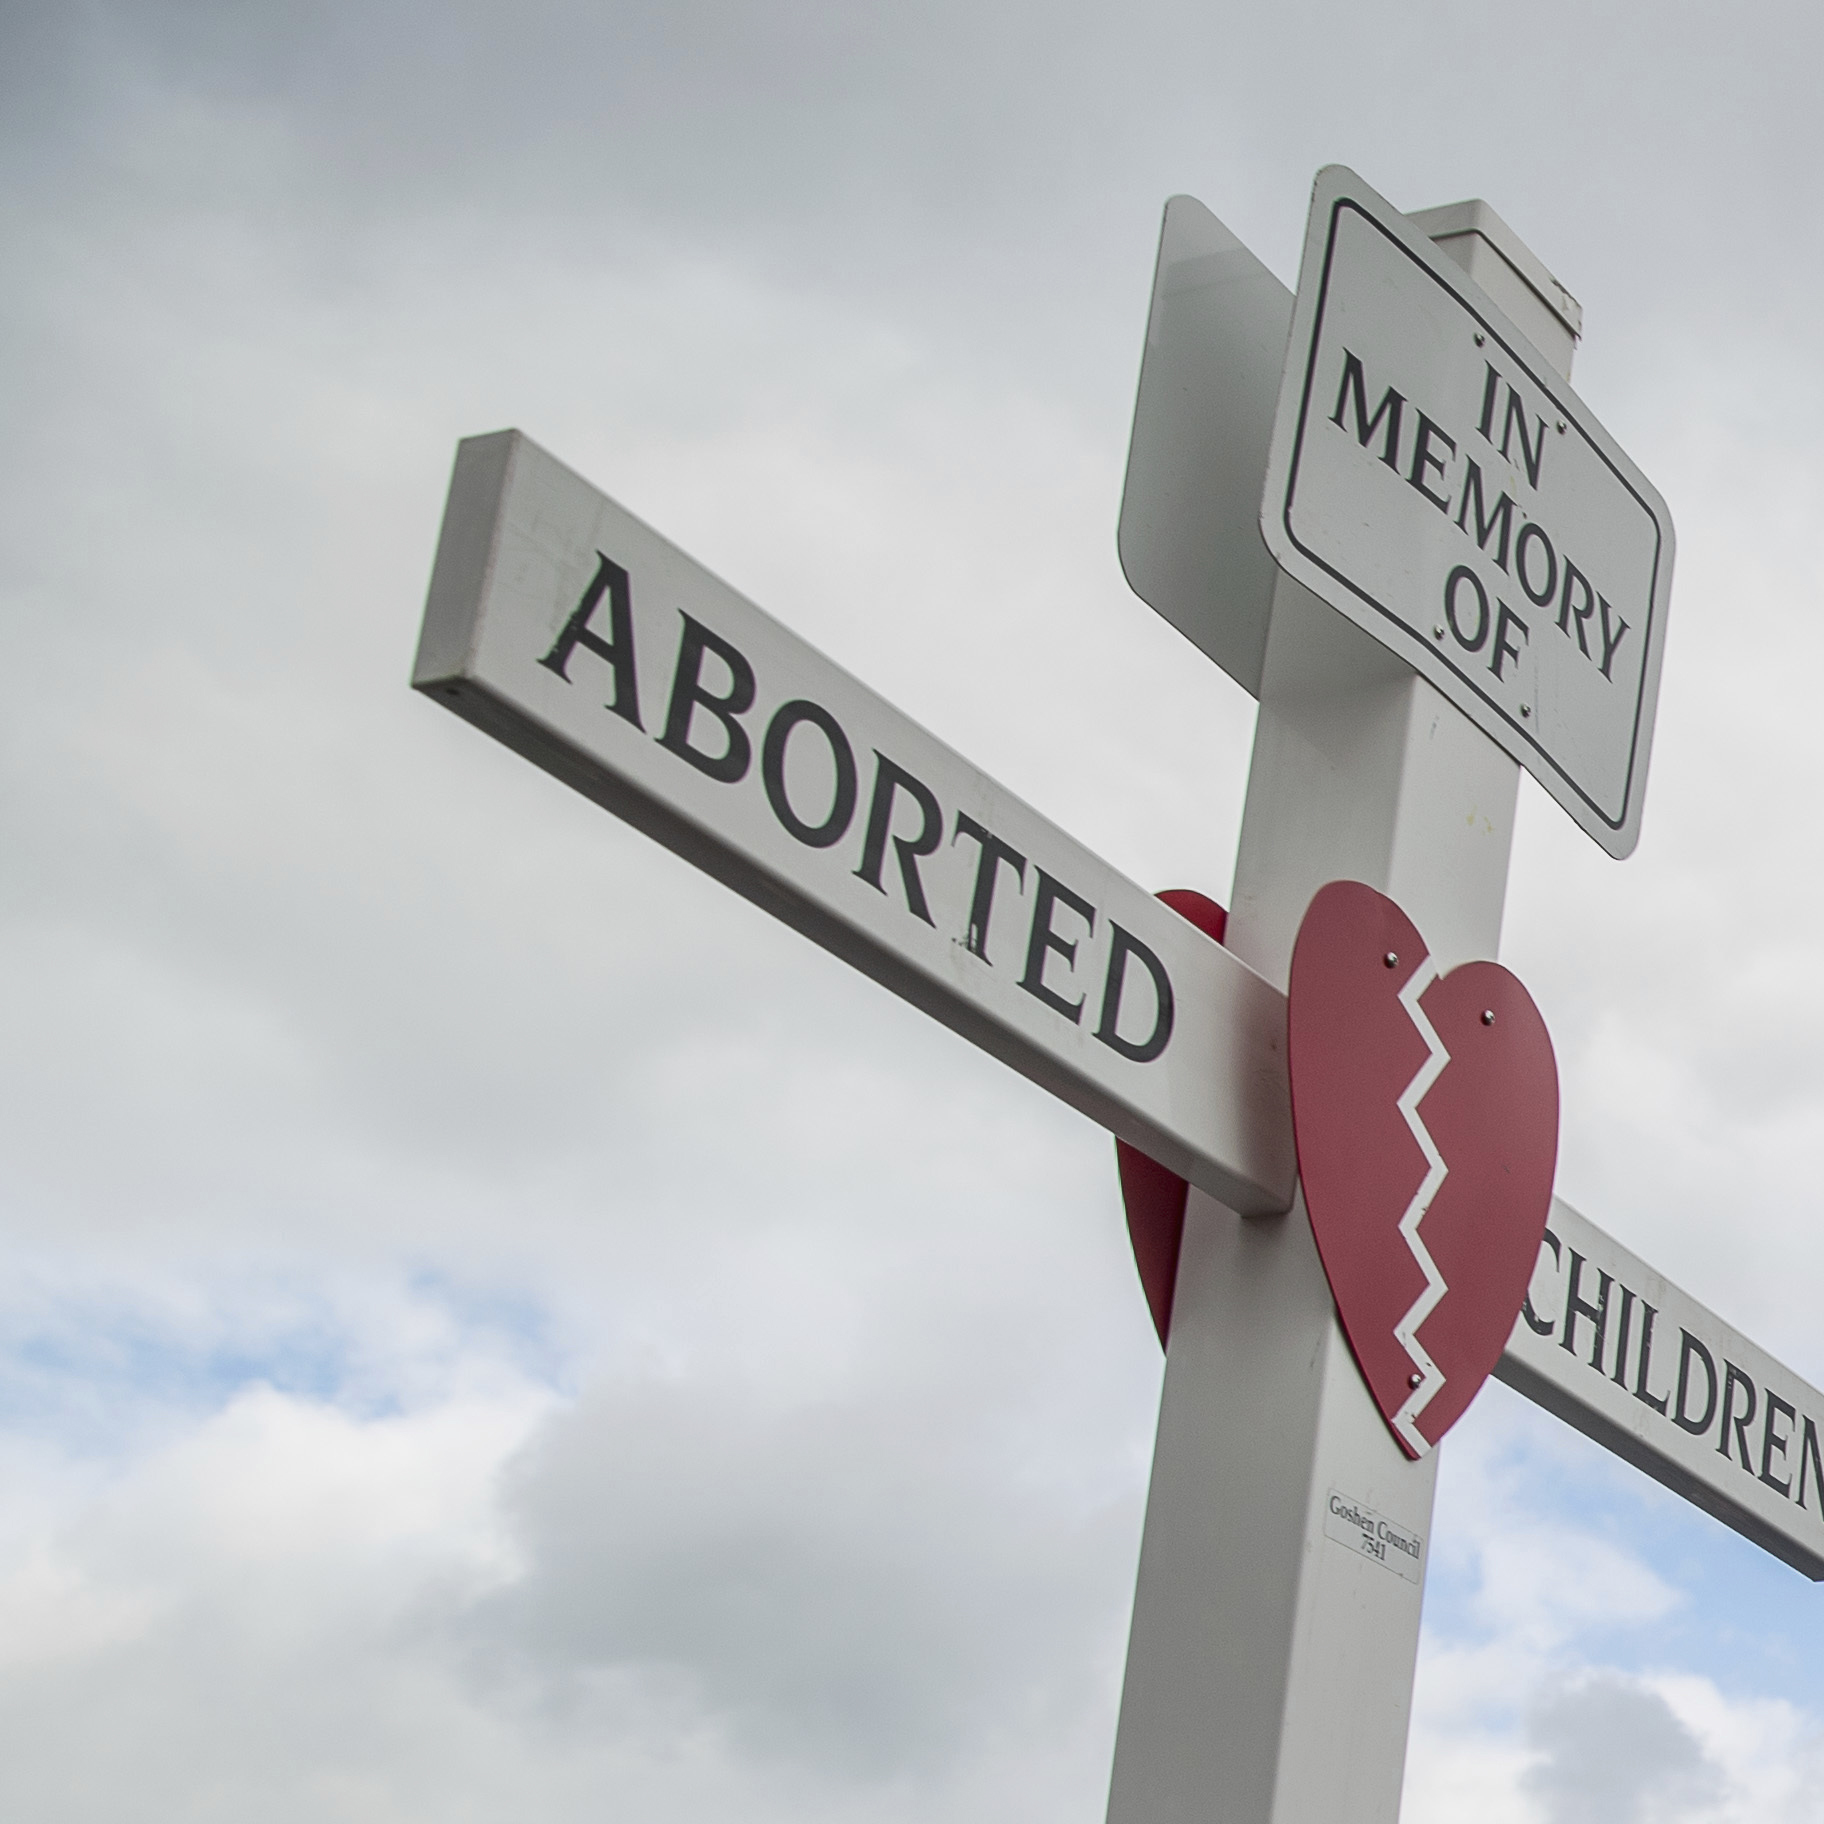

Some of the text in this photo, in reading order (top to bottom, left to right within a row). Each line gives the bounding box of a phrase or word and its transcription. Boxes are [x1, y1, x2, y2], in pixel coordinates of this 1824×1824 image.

[1475, 358, 1550, 491] IN
[1327, 345, 1632, 684] MEMORY
[1443, 564, 1531, 683] OF
[536, 550, 1176, 1064] ABORTED
[1328, 1495, 1421, 1560] Goshen Council
[1360, 1533, 1386, 1562] 7541
